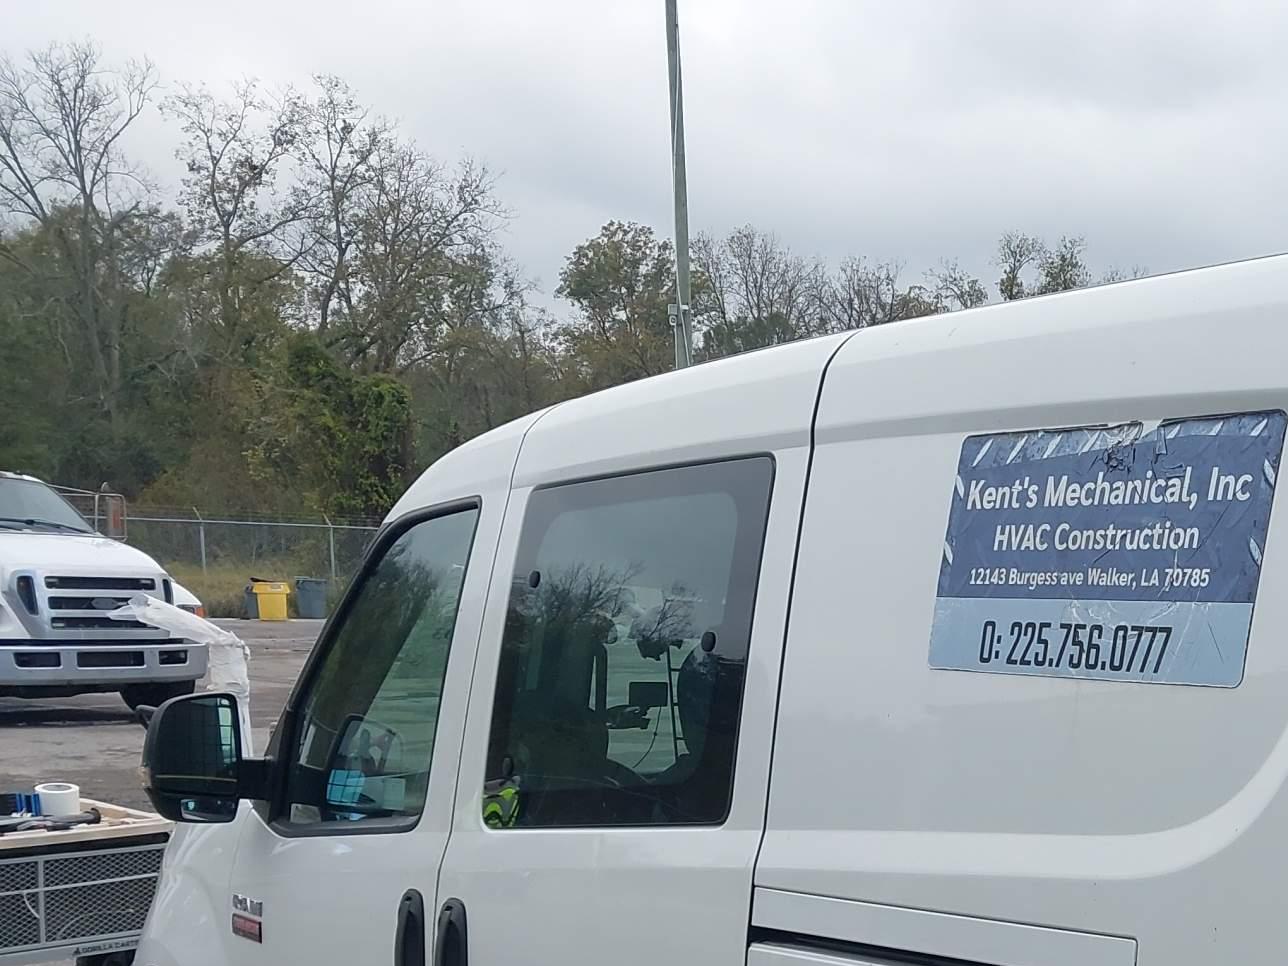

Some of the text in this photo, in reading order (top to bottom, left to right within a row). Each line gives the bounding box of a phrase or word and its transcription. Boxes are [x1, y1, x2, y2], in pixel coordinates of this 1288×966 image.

[966, 466, 1253, 511] Kent's Mechanical, Inc
[993, 521, 1200, 552] HVAC Construction
[969, 567, 1211, 590] 12143 Burgess ave Walker, LA 70785
[1005, 620, 1174, 674] 225.756.0777
